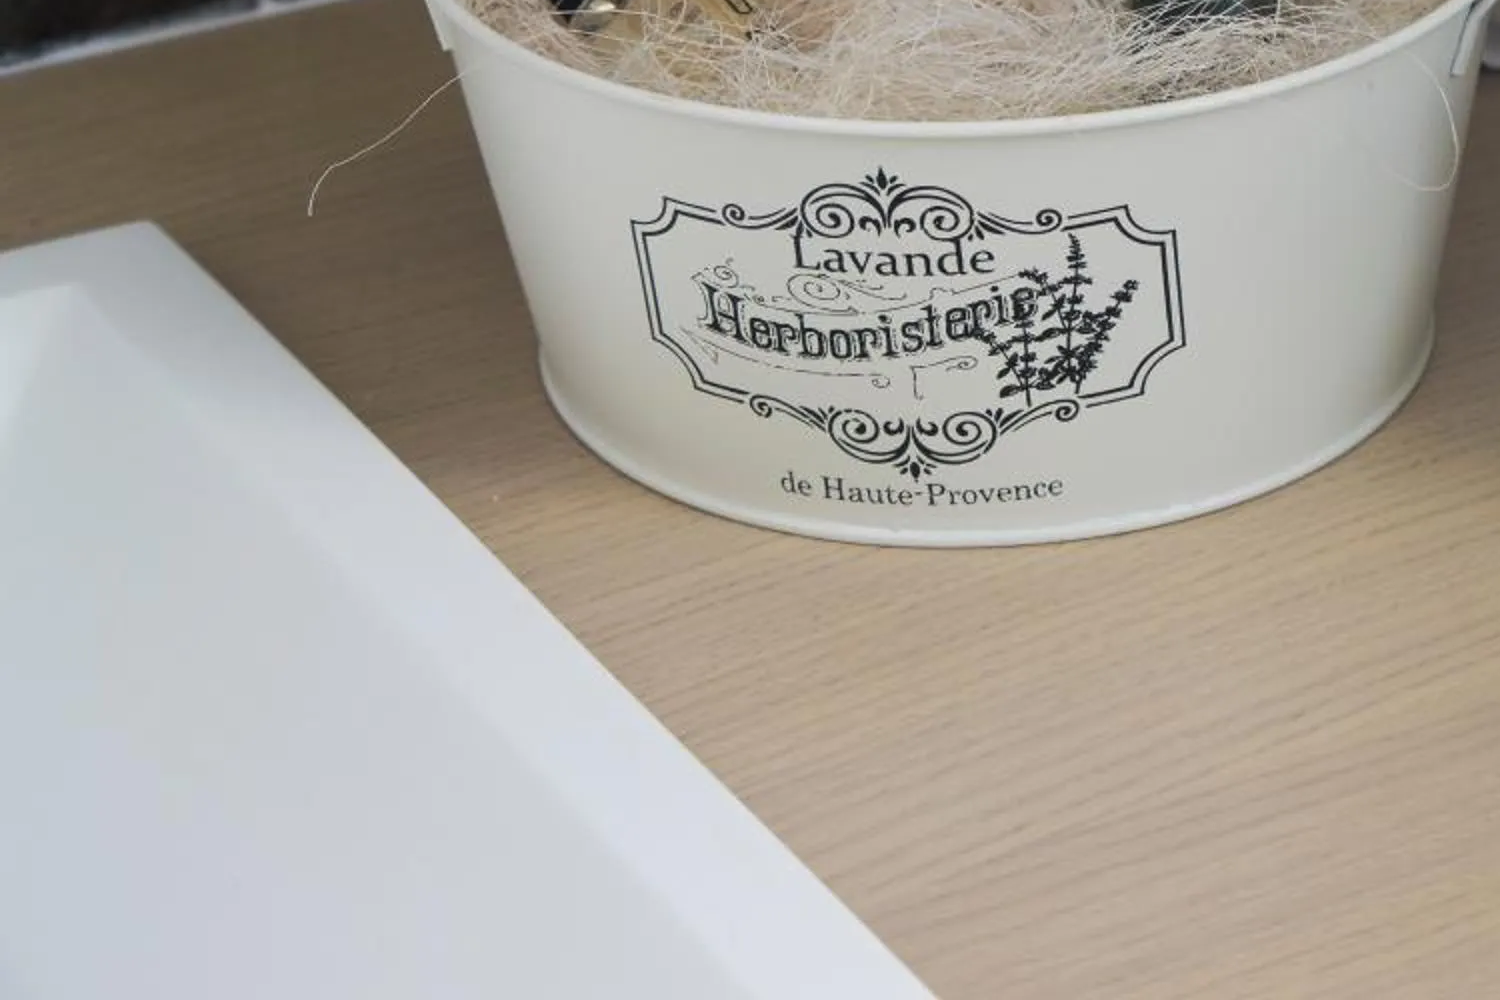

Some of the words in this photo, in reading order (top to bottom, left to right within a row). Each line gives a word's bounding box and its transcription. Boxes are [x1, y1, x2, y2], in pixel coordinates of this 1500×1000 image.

[792, 231, 996, 277] Lavande
[699, 282, 1039, 362] Herboristerie
[779, 470, 812, 497] de
[822, 475, 1064, 507] Haute-Provence
